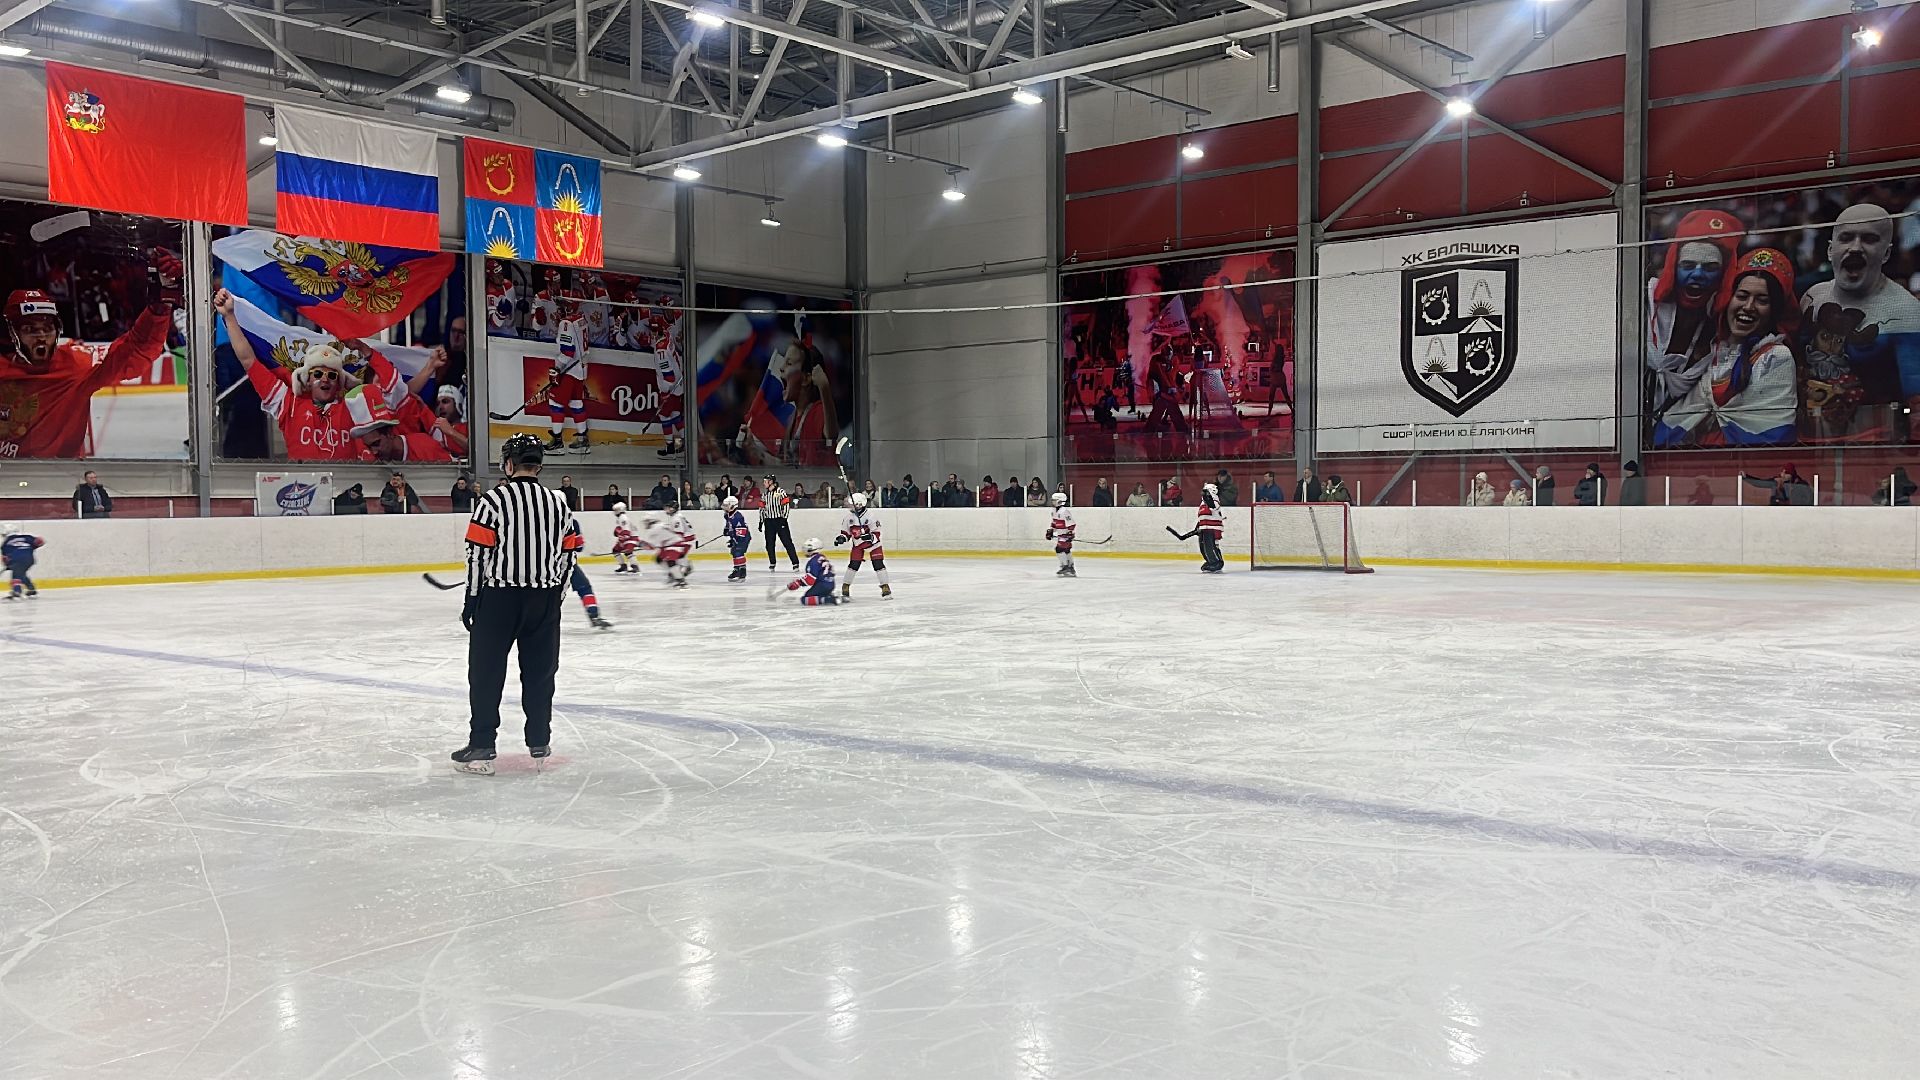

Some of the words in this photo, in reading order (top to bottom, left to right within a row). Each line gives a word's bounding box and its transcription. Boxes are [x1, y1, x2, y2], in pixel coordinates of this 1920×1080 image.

[1400, 251, 1423, 267] ХК
[1427, 242, 1520, 260] БАЛАШИХА
[610, 383, 659, 416] Boh
[300, 426, 350, 448] СССР
[1382, 431, 1413, 439] СШОР
[1415, 429, 1455, 438] ИМЕНИ
